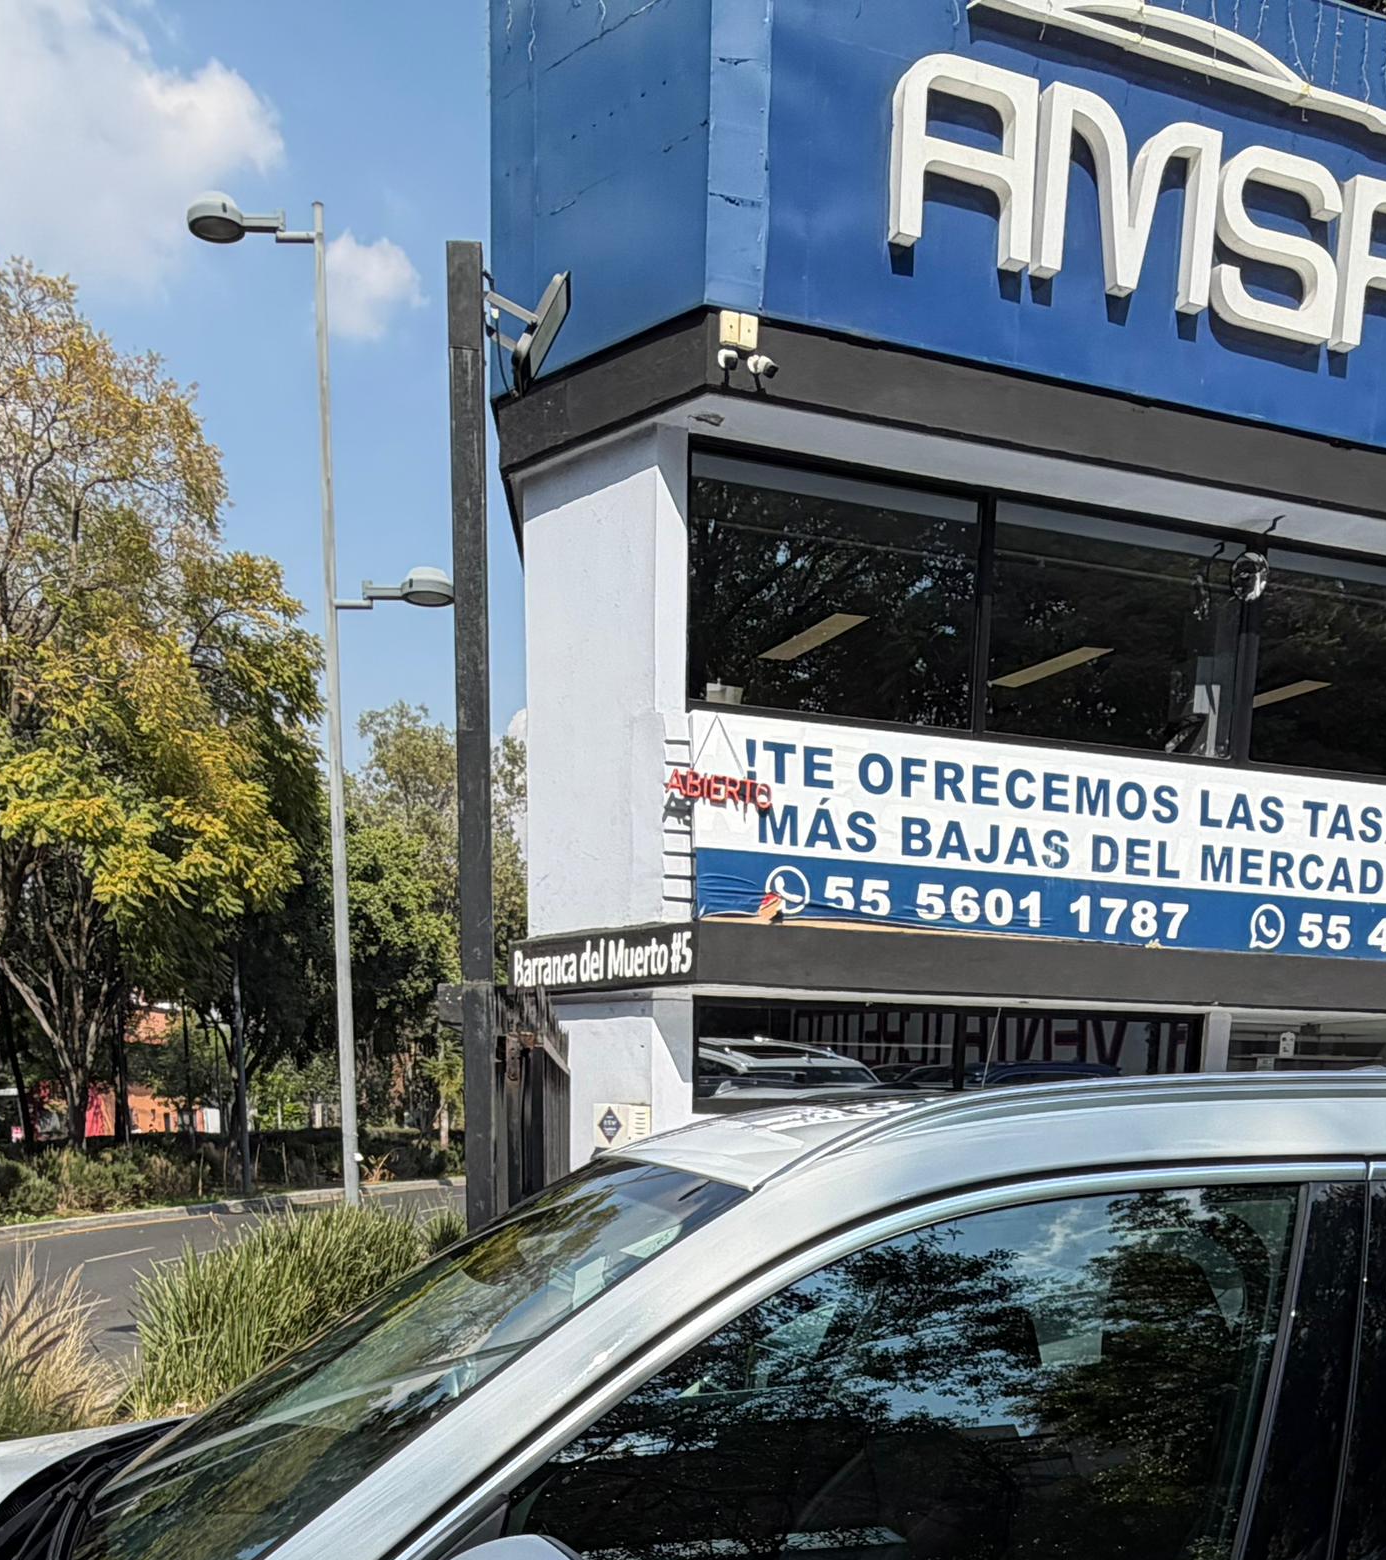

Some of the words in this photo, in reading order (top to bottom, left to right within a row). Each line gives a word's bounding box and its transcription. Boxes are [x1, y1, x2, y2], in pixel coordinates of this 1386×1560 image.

[665, 768, 773, 809] ABIERTO
[858, 752, 1179, 824] OFRECEMOS
[1200, 789, 1284, 834] LAS
[758, 797, 877, 854] MÁS
[901, 816, 1070, 870] BAJAS
[1091, 834, 1180, 880] DEL
[824, 876, 892, 918] 55
[915, 882, 1042, 929] 5601
[1070, 895, 1191, 940] 1787
[1297, 912, 1352, 951] 55
[514, 950, 577, 988] Barranca
[580, 938, 605, 982] del
[607, 938, 668, 980] Muerto
[671, 930, 693, 974] #5
